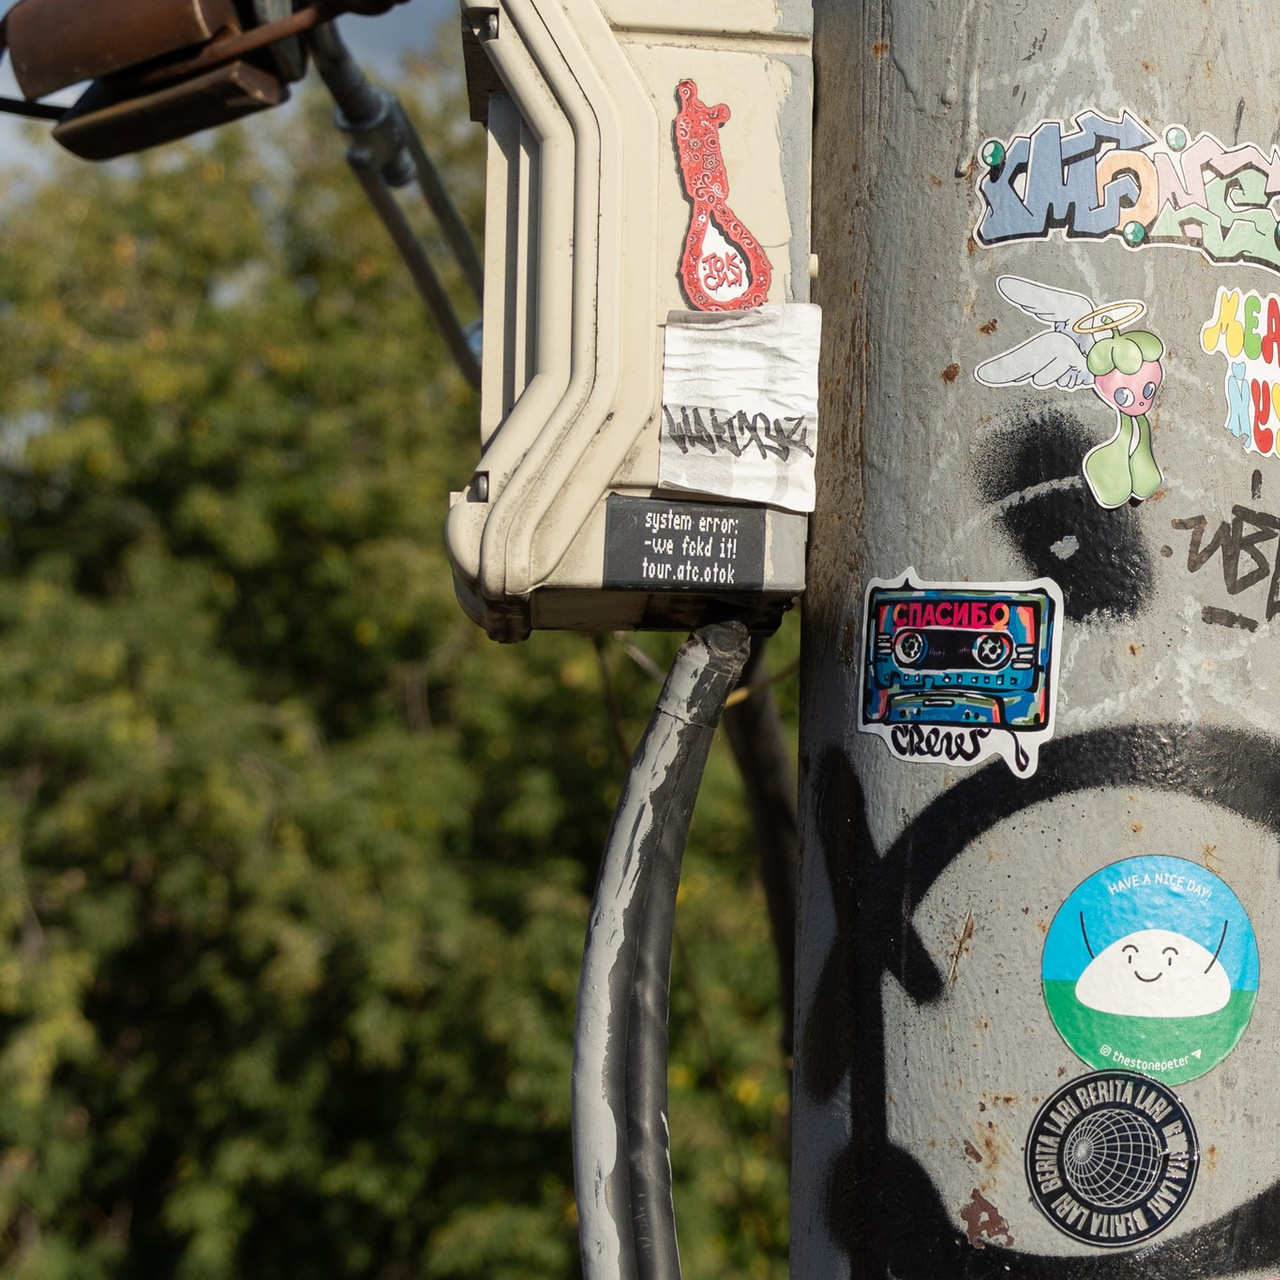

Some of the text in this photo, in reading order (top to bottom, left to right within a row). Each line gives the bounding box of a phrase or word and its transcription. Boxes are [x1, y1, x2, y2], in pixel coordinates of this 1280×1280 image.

[645, 509, 739, 534] system error:
[644, 535, 737, 559] -we fckd it!
[642, 557, 735, 584] tour.atc.otok
[892, 602, 1010, 629] СПАСИБО
[1108, 872, 1213, 901] HAVE A NICE DAY!
[1112, 1050, 1190, 1072] thestonepeter
[1075, 1079, 1134, 1110] BERITA
[1134, 1085, 1173, 1123] LARI
[1043, 1094, 1082, 1135] LARI
[1162, 1119, 1189, 1179] BITA
[1036, 1134, 1063, 1195] BERITA
[1051, 1192, 1091, 1230] LARI
[1147, 1179, 1183, 1220] LARI
[1090, 1207, 1149, 1237] BERITA
